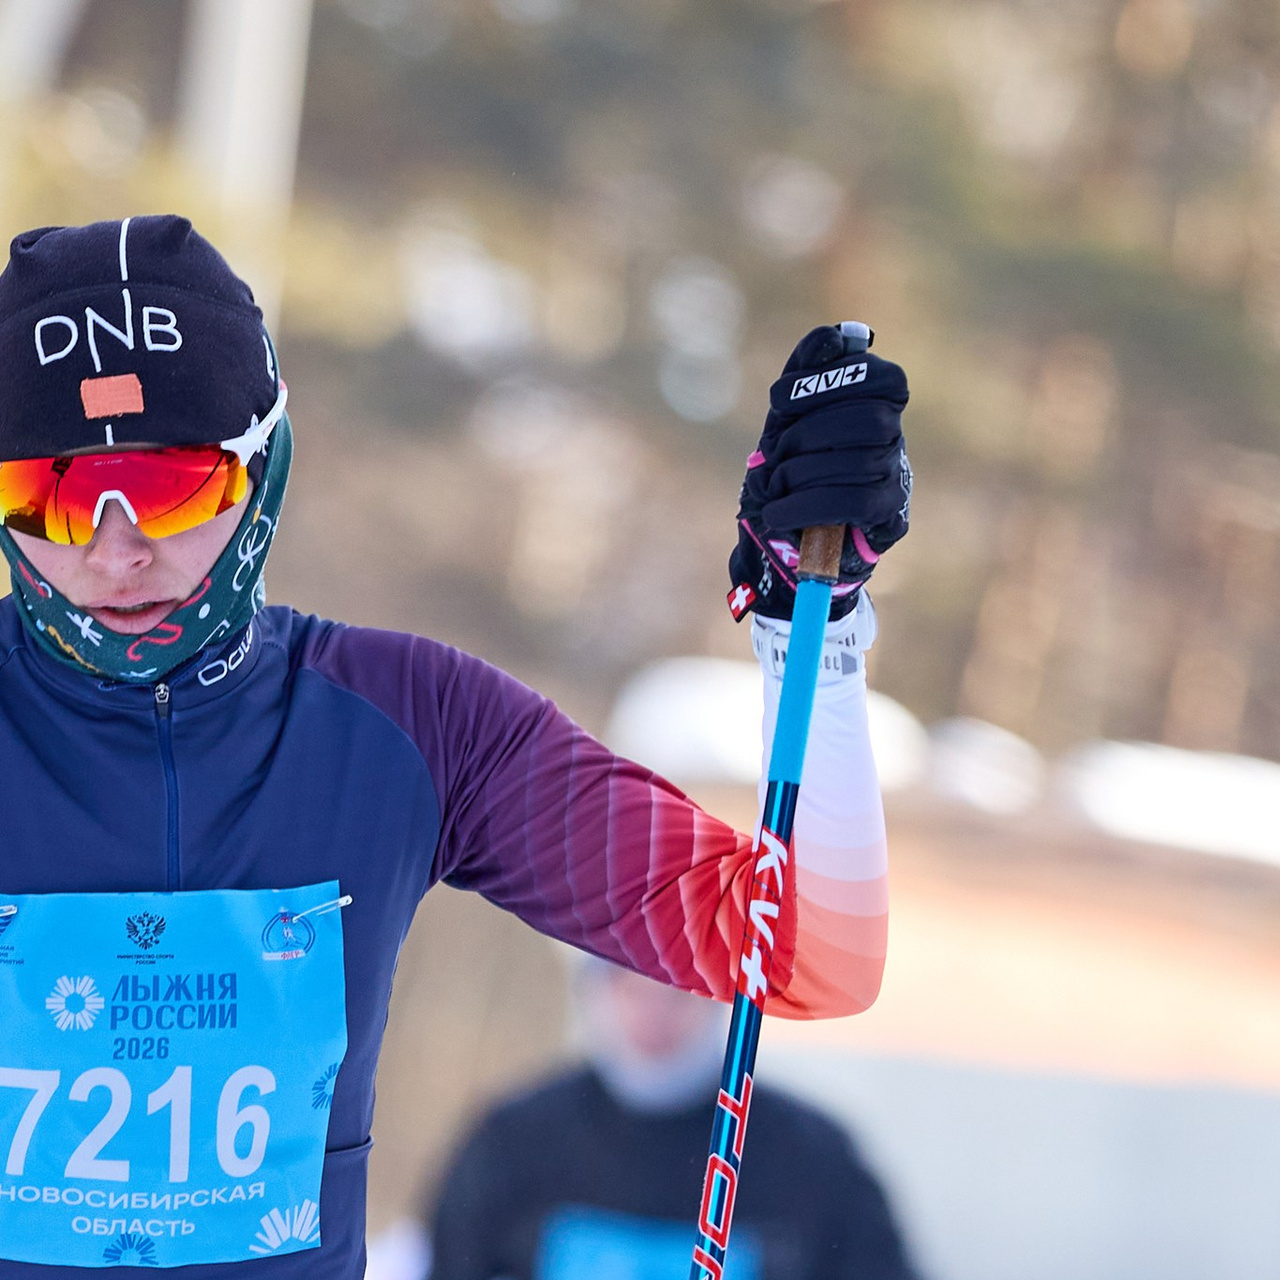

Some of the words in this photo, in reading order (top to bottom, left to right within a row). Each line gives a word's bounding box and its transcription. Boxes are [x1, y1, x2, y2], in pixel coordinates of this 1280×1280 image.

[35, 288, 183, 373] DNB
[792, 363, 867, 399] KV+
[111, 973, 238, 1002] ЛЫЖНЯ
[110, 1003, 238, 1031] РОССИИ
[112, 1037, 170, 1060] 2026
[71, 1215, 196, 1237] ОБЛАСТЬ
